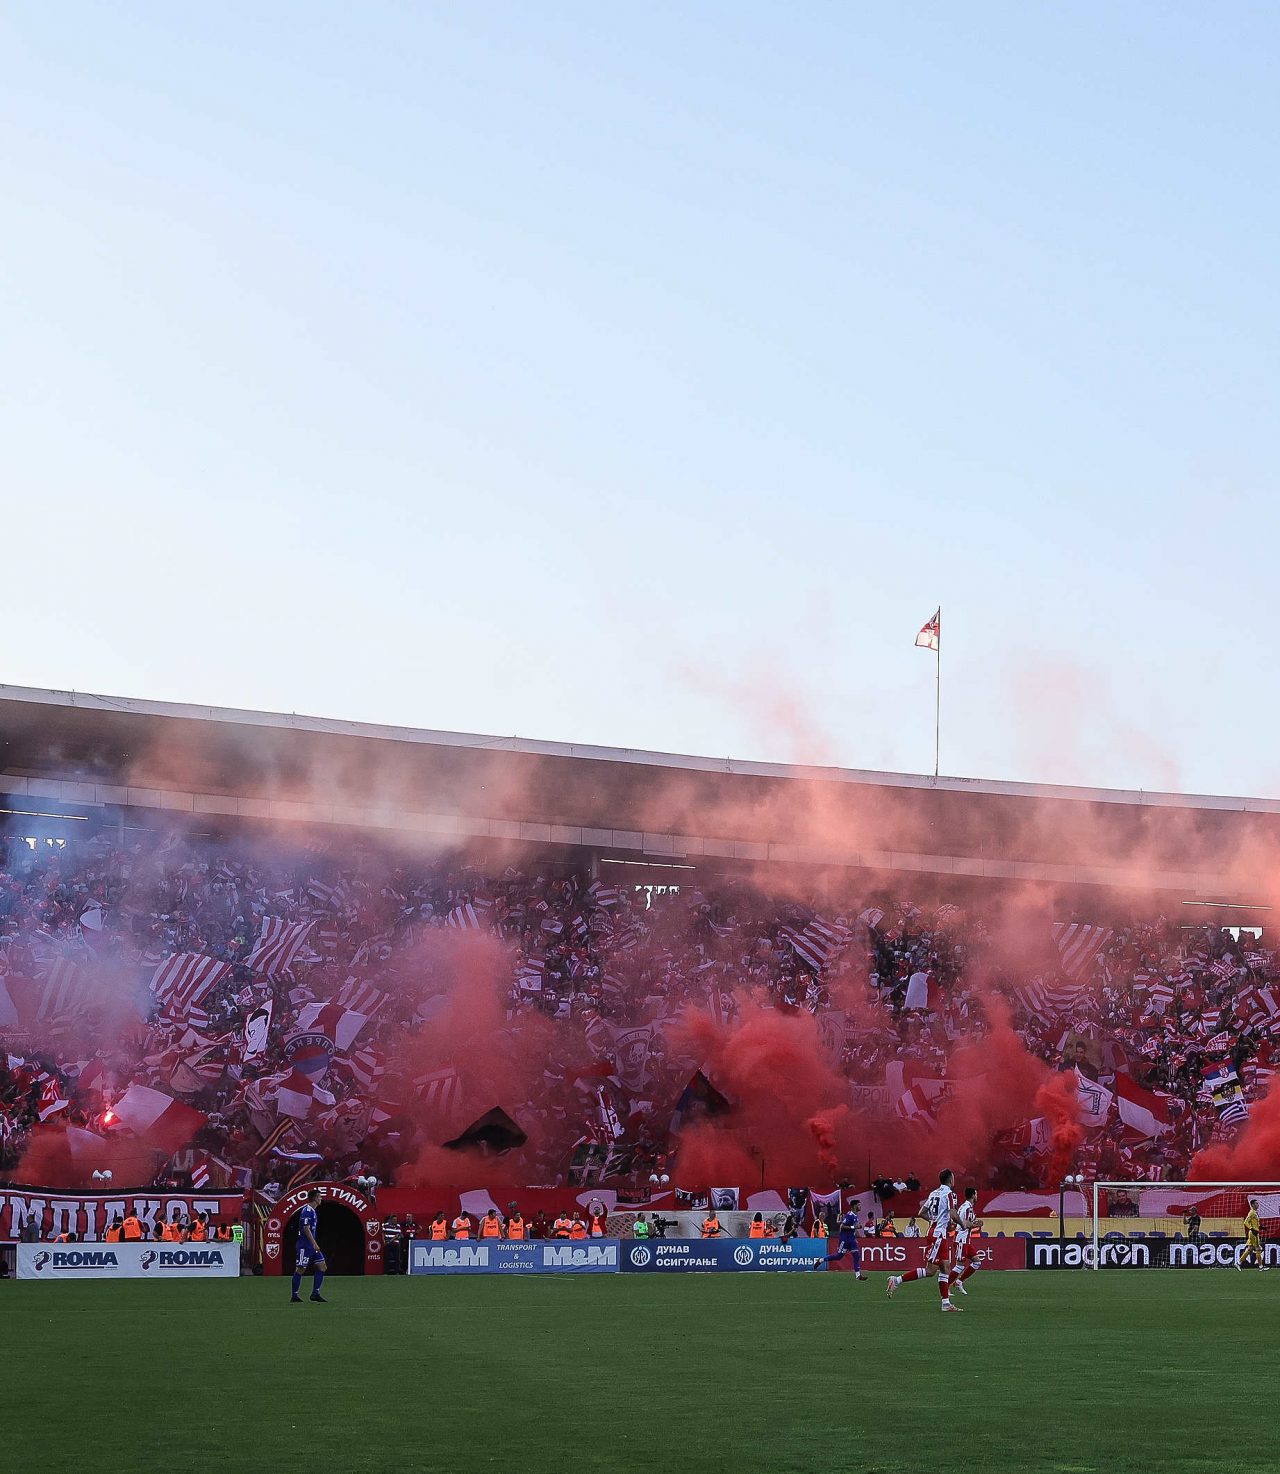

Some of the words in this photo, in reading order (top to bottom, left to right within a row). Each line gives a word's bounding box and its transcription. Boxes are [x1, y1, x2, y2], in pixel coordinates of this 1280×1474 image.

[330, 1187, 368, 1212] ТИМ!
[159, 1249, 224, 1265] ROMA
[414, 1247, 489, 1267] M&M
[543, 1246, 617, 1266] M&M
[656, 1245, 690, 1254] ДУНАВ
[759, 1245, 793, 1254] ДУНАВ
[861, 1243, 906, 1262] mts
[1034, 1243, 1150, 1266] macron
[52, 1251, 119, 1266] ROMA
[499, 1261, 534, 1269] LOGISTICS
[656, 1258, 718, 1267] ОСИГУРАЊЕ
